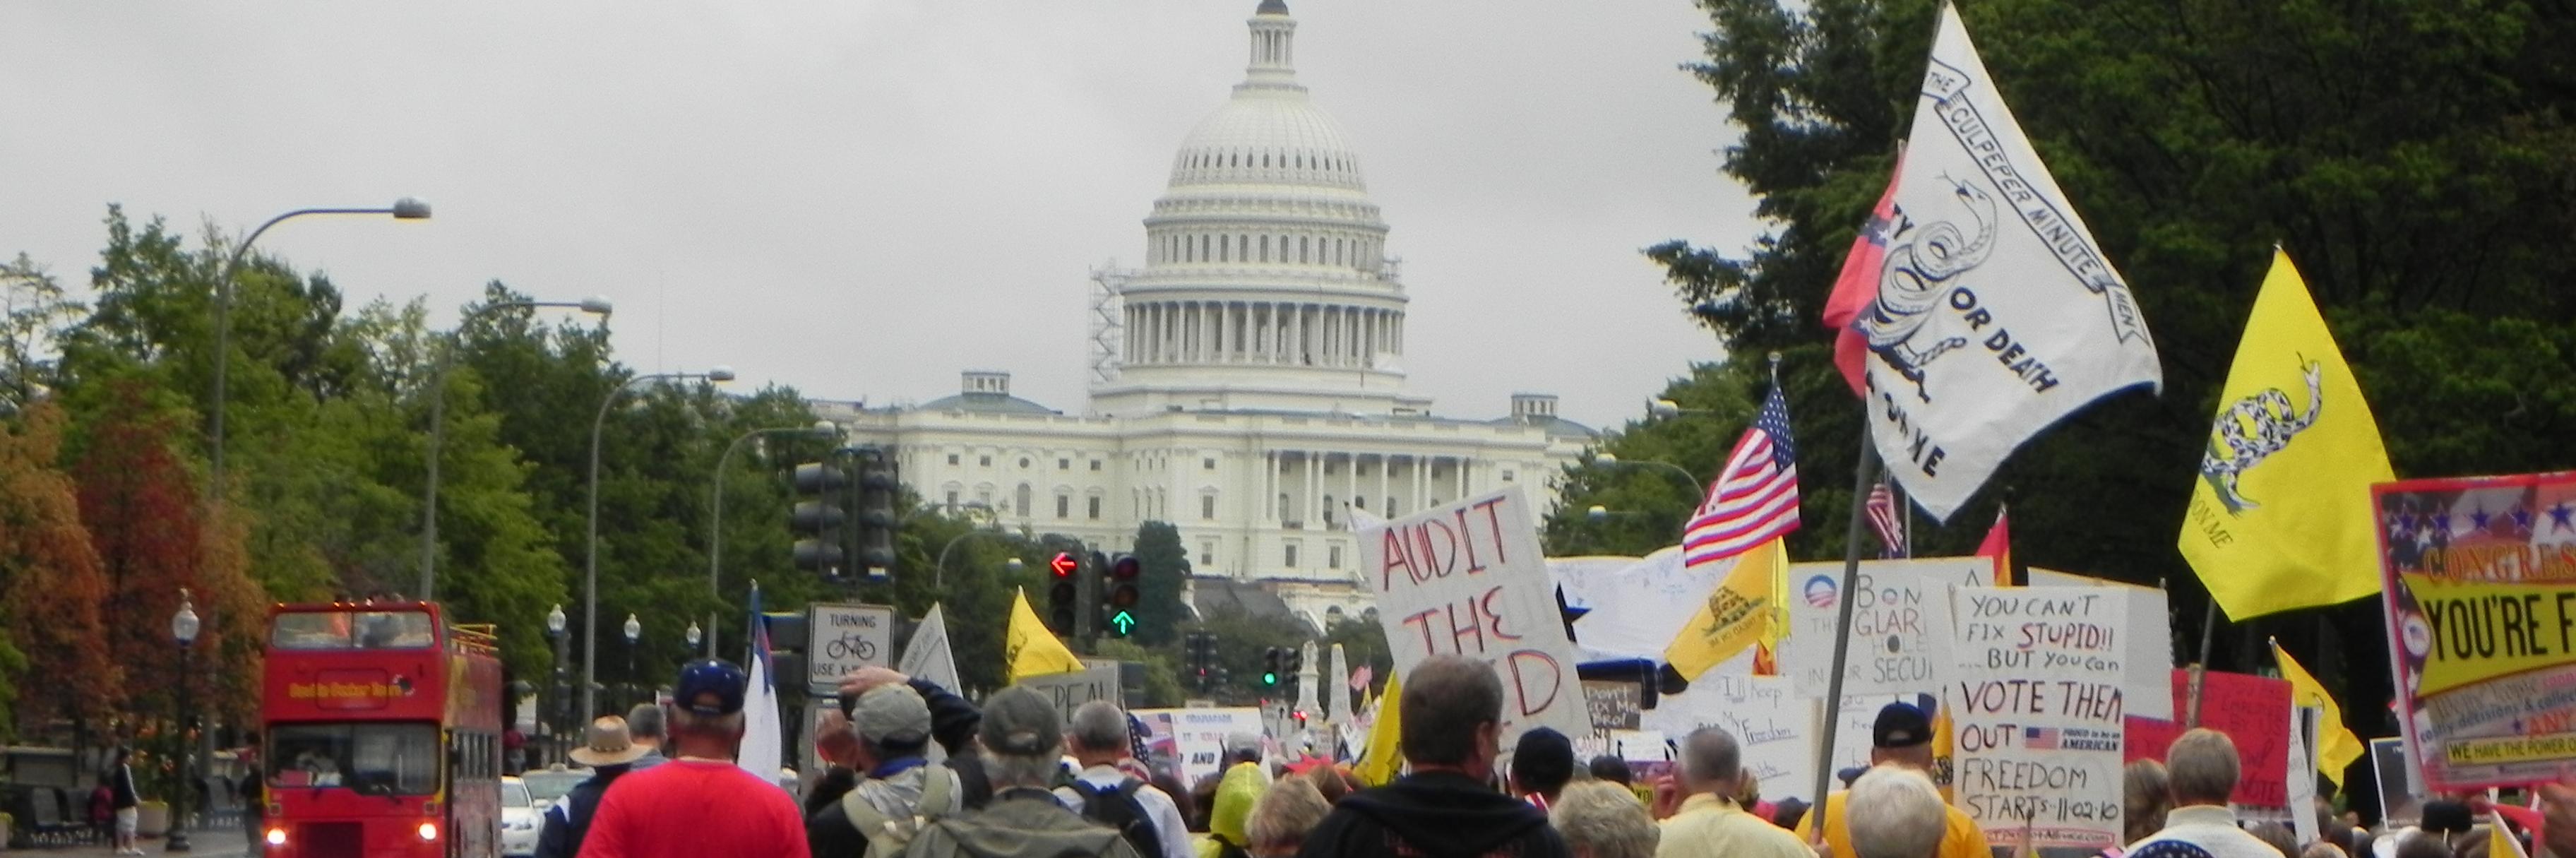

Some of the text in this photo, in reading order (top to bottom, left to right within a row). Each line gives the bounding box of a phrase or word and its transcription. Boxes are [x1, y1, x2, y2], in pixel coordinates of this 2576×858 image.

[1928, 71, 2136, 333] THE CULPEPER MINUTE MEN
[1950, 286, 1992, 332] OR
[1983, 327, 2061, 395] DEATH
[1383, 495, 1506, 592] AUDIT
[830, 613, 876, 628] TURNING
[1402, 585, 1523, 656] THE
[1971, 594, 2100, 617] YOU CAN'T
[1967, 621, 2114, 651] FIX STUPID!!
[2423, 593, 2548, 662] YOU'RE
[812, 662, 835, 677] USE
[1961, 679, 2046, 714] VOTE
[1961, 724, 2017, 753] OUT
[2061, 738, 2120, 751] AMERICAN
[2448, 744, 2471, 759] WE
[2474, 744, 2501, 758] HAVE
[2507, 743, 2526, 756] THE
[1191, 751, 1215, 765] AND
[1962, 757, 2087, 793] FREEDOM
